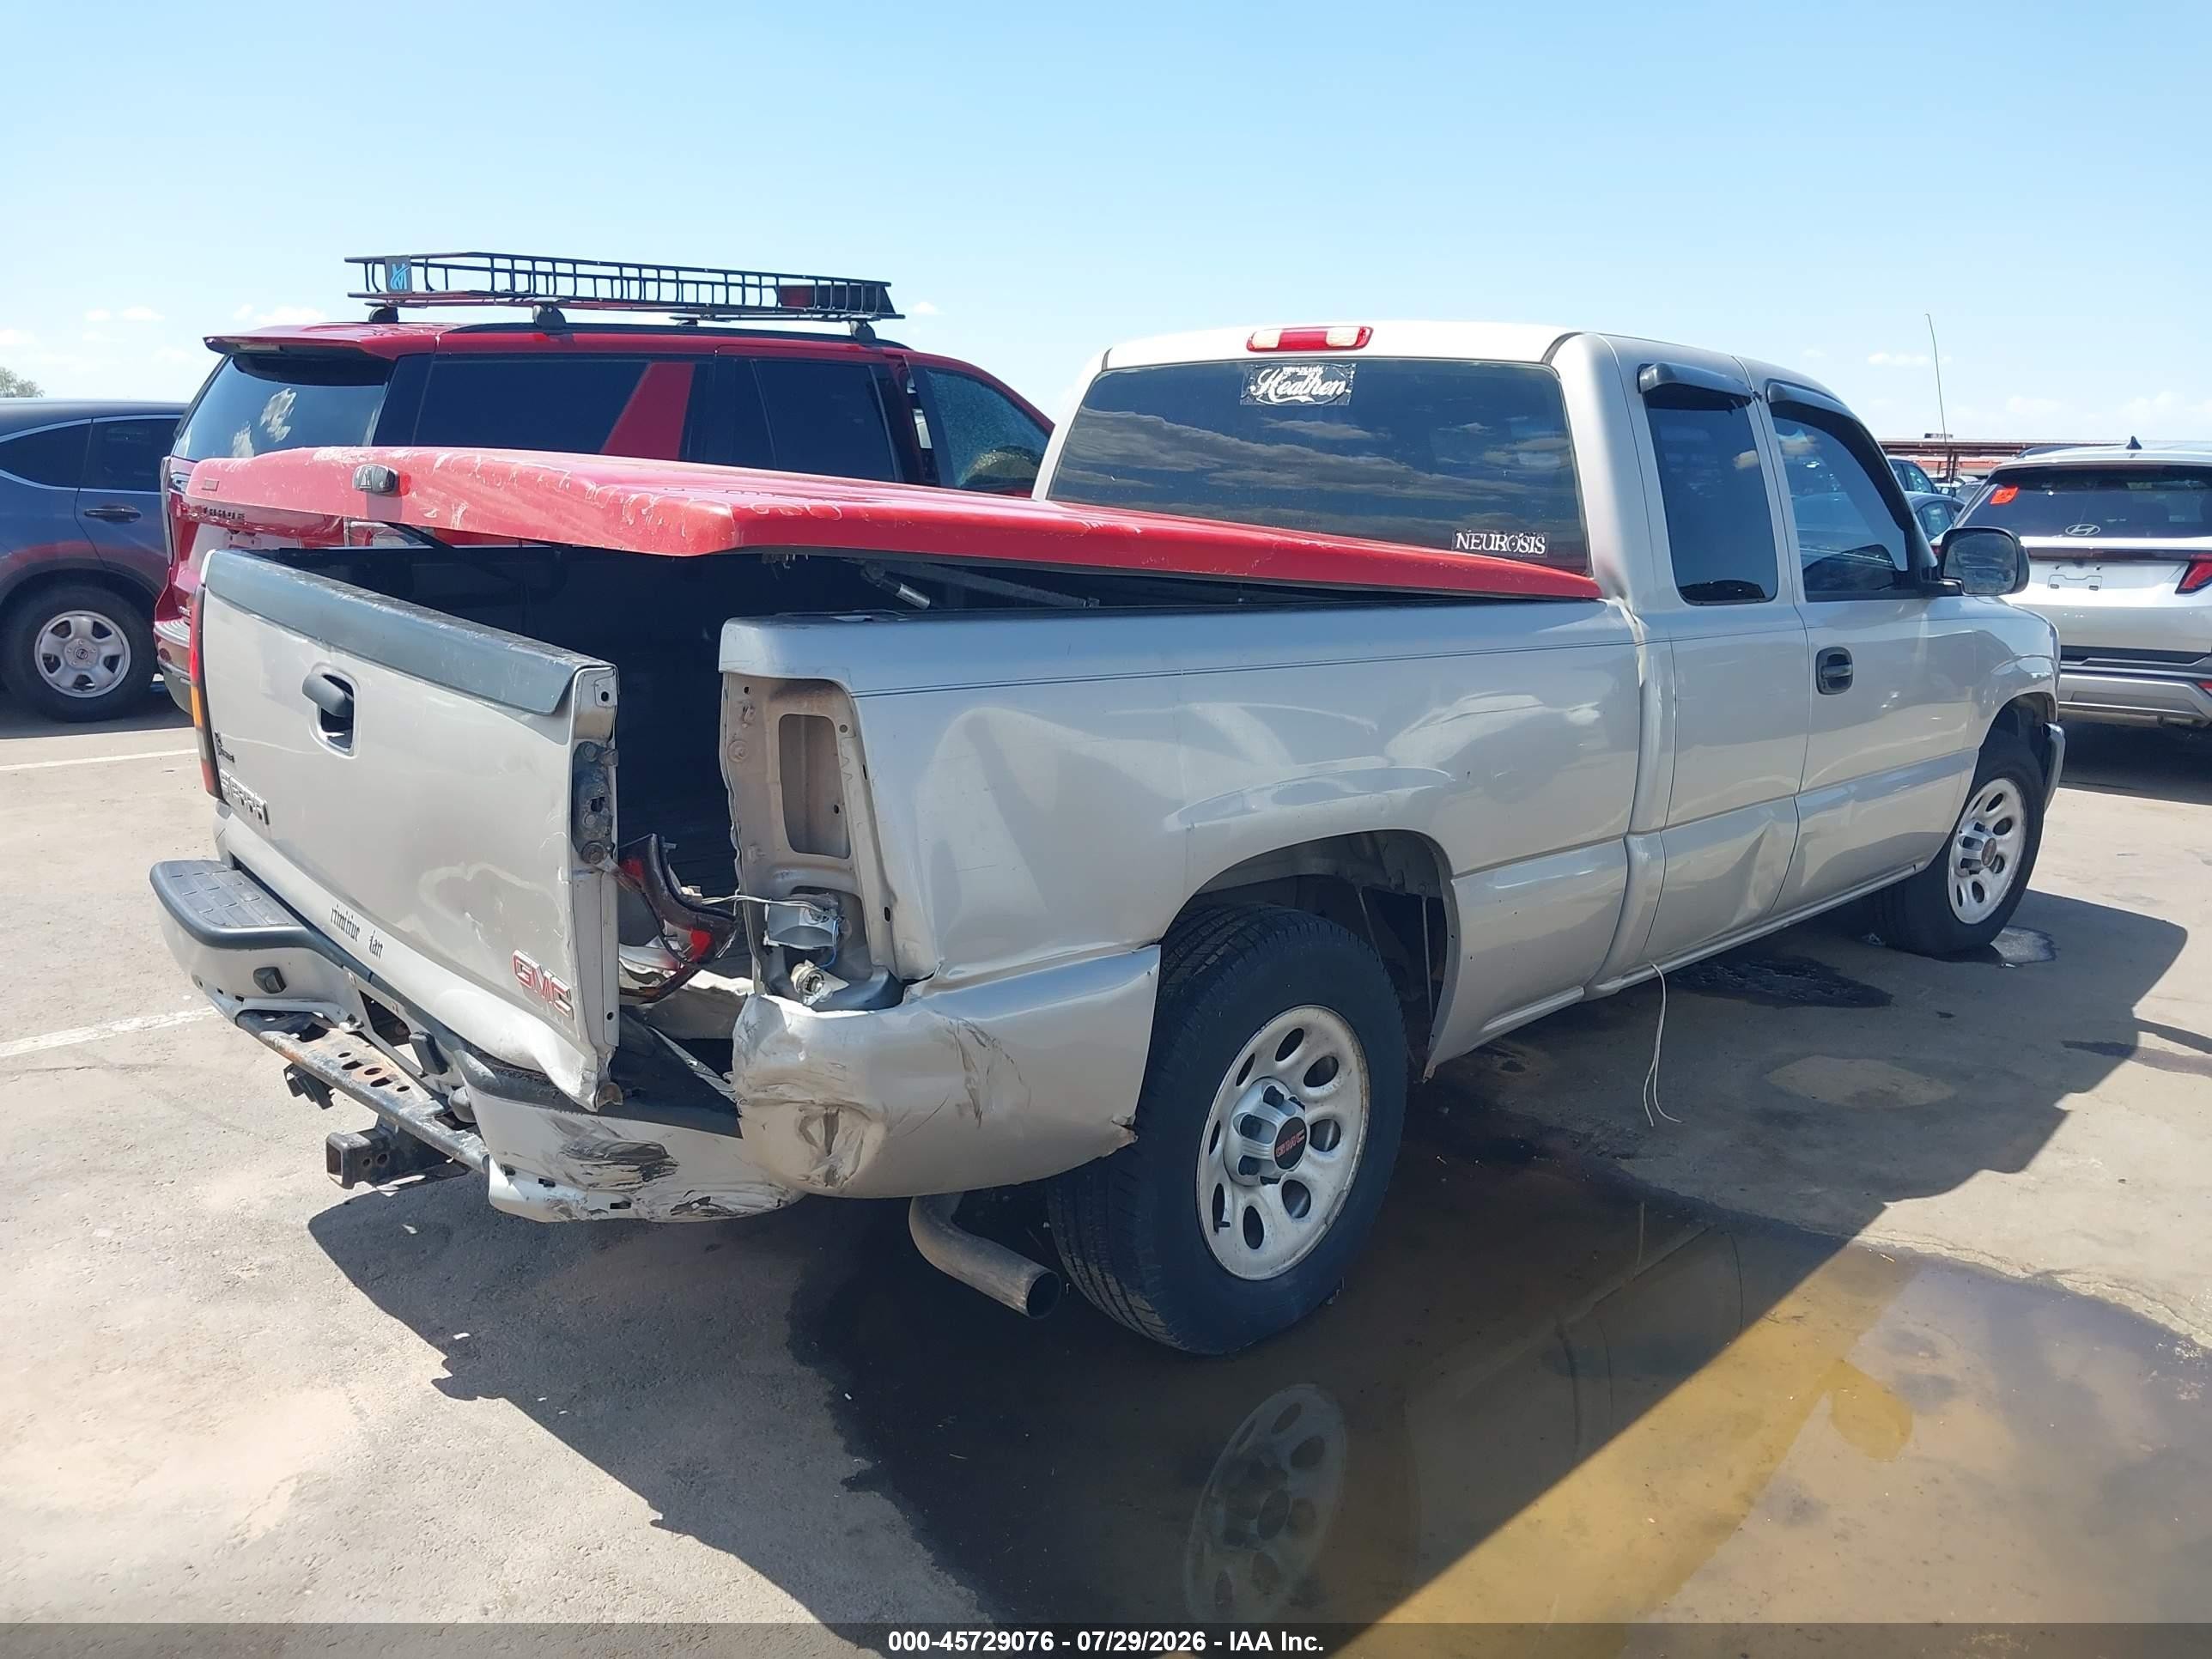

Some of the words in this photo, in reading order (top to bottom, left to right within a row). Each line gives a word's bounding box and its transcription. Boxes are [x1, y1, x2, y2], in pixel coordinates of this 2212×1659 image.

[1251, 368, 1348, 403] Heathen
[1455, 530, 1547, 555] NEUROSIS
[513, 949, 574, 1020] GMC
[1275, 1128, 1306, 1158] GMC
